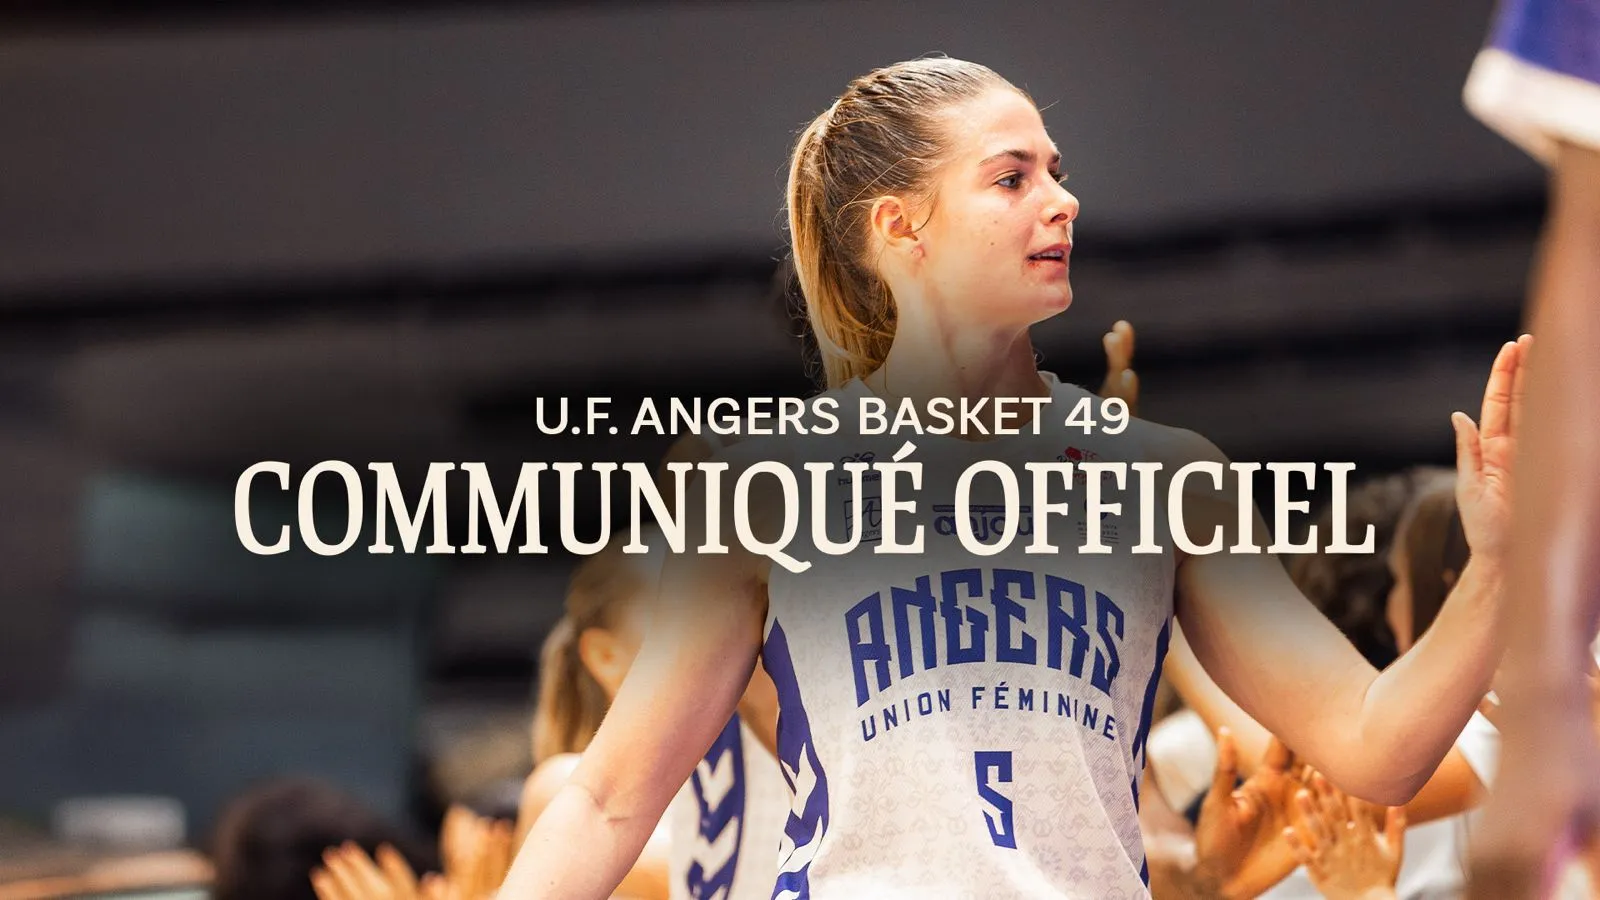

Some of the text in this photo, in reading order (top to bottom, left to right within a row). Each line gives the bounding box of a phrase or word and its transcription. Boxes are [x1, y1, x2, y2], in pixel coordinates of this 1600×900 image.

[844, 568, 1124, 708] ANGERS
[861, 681, 1117, 742] UNION FÉMININE
